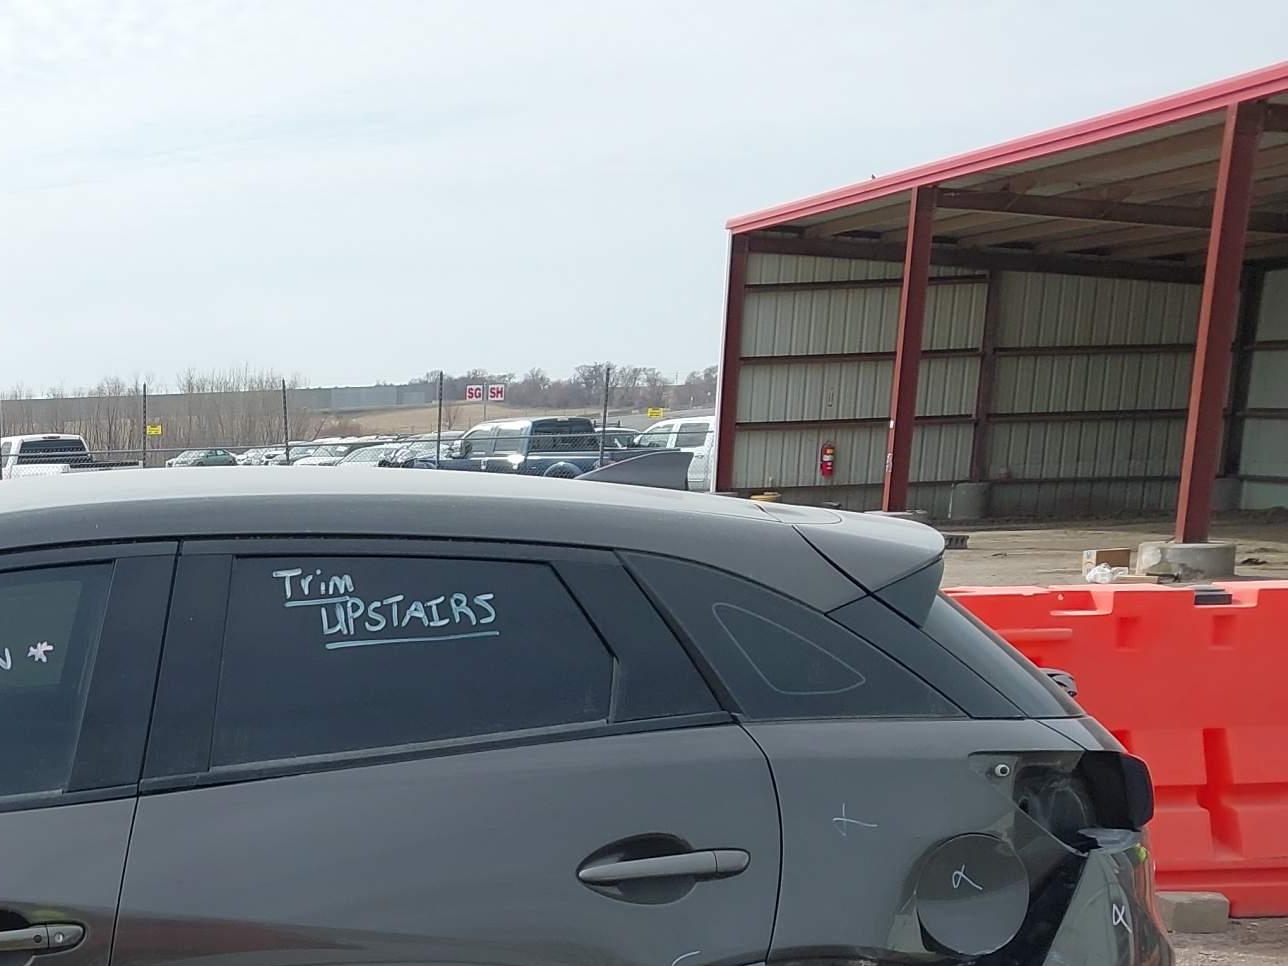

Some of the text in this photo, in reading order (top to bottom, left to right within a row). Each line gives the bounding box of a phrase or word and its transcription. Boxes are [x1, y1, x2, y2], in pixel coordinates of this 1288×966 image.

[467, 387, 481, 399] SG
[489, 387, 503, 398] SH
[273, 568, 354, 599] Trim
[321, 593, 496, 635] UPSTAIRS
